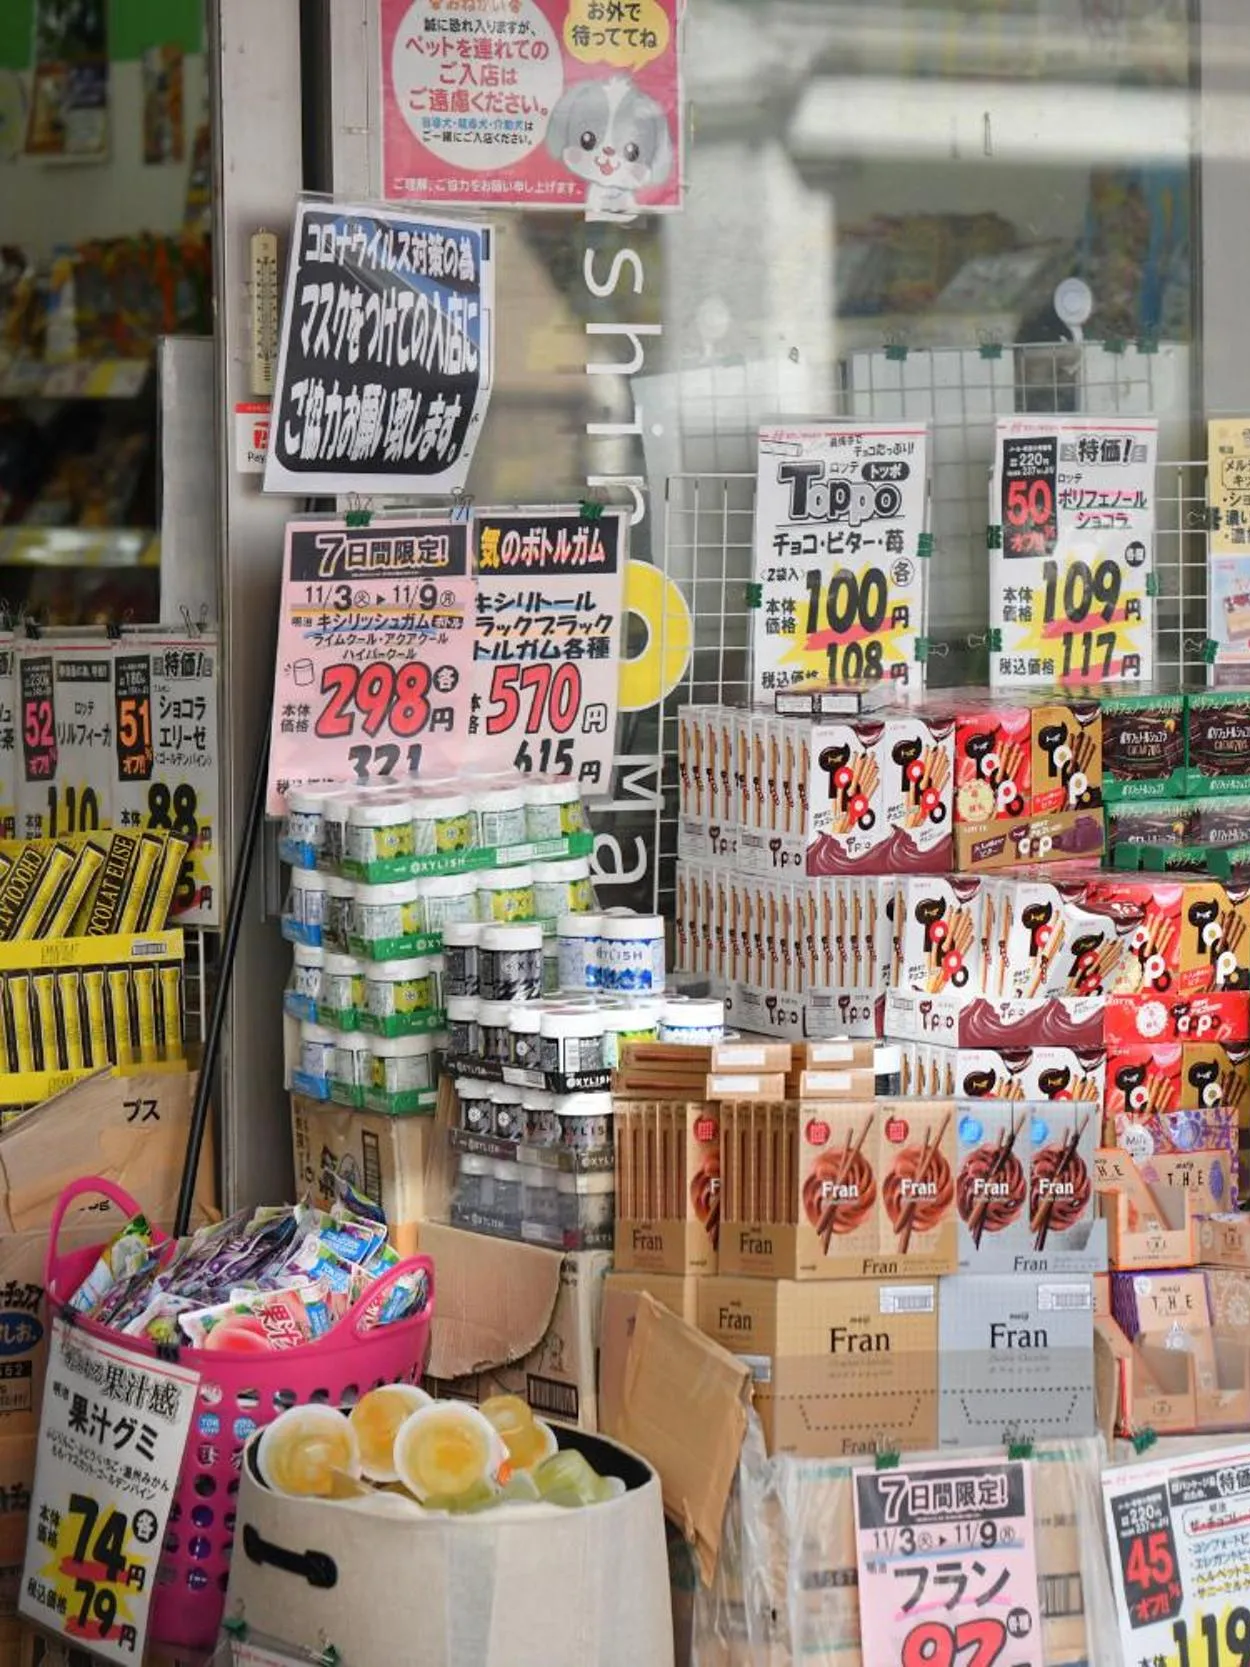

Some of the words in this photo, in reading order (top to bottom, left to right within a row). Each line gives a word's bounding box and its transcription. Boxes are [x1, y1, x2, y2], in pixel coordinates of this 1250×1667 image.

[588, 3, 640, 23] お外で
[406, 38, 549, 60] ペットを連れての
[572, 26, 657, 48] 待っててね
[439, 64, 517, 86] ご入店は
[409, 87, 548, 115] ご遠慮ください。
[300, 281, 478, 375] マスクをつけての入店に
[1077, 437, 1132, 463] 特価!
[777, 459, 903, 528] Toppo
[1007, 479, 1053, 527] 50
[1057, 486, 1148, 509] ポリフェノール
[1075, 511, 1132, 530] ショコラ
[316, 533, 449, 577] 7日間限定!
[772, 529, 905, 557] チョコ・ビター・苺
[766, 598, 797, 615] 本体
[1002, 586, 1033, 605] 本体
[765, 616, 797, 635] 価格
[1002, 604, 1033, 623] 価格
[164, 651, 205, 677] 特価!
[1000, 656, 1055, 677] 税込価格
[159, 697, 206, 719] ショコラ
[25, 701, 54, 748] 52
[119, 699, 151, 748] 51
[159, 725, 207, 750] エリーゼ
[107, 835, 137, 879] ELISE
[822, 1180, 859, 1199] Fran
[901, 1179, 937, 1196] Fran
[974, 1178, 1010, 1196] Fran
[1038, 1178, 1075, 1196] Fran
[632, 1230, 663, 1252] Fran
[740, 1231, 773, 1255] Fran
[862, 1257, 898, 1275] Fran
[1013, 1255, 1048, 1272] Fran
[718, 1306, 752, 1331] Fran
[829, 1326, 891, 1354] Fran
[989, 1323, 1048, 1350] Fran
[67, 1392, 159, 1461] 果汁グミ
[879, 1473, 1008, 1524] 7日間限定!
[1126, 1531, 1174, 1589] 45
[894, 1561, 1011, 1613] フラン
